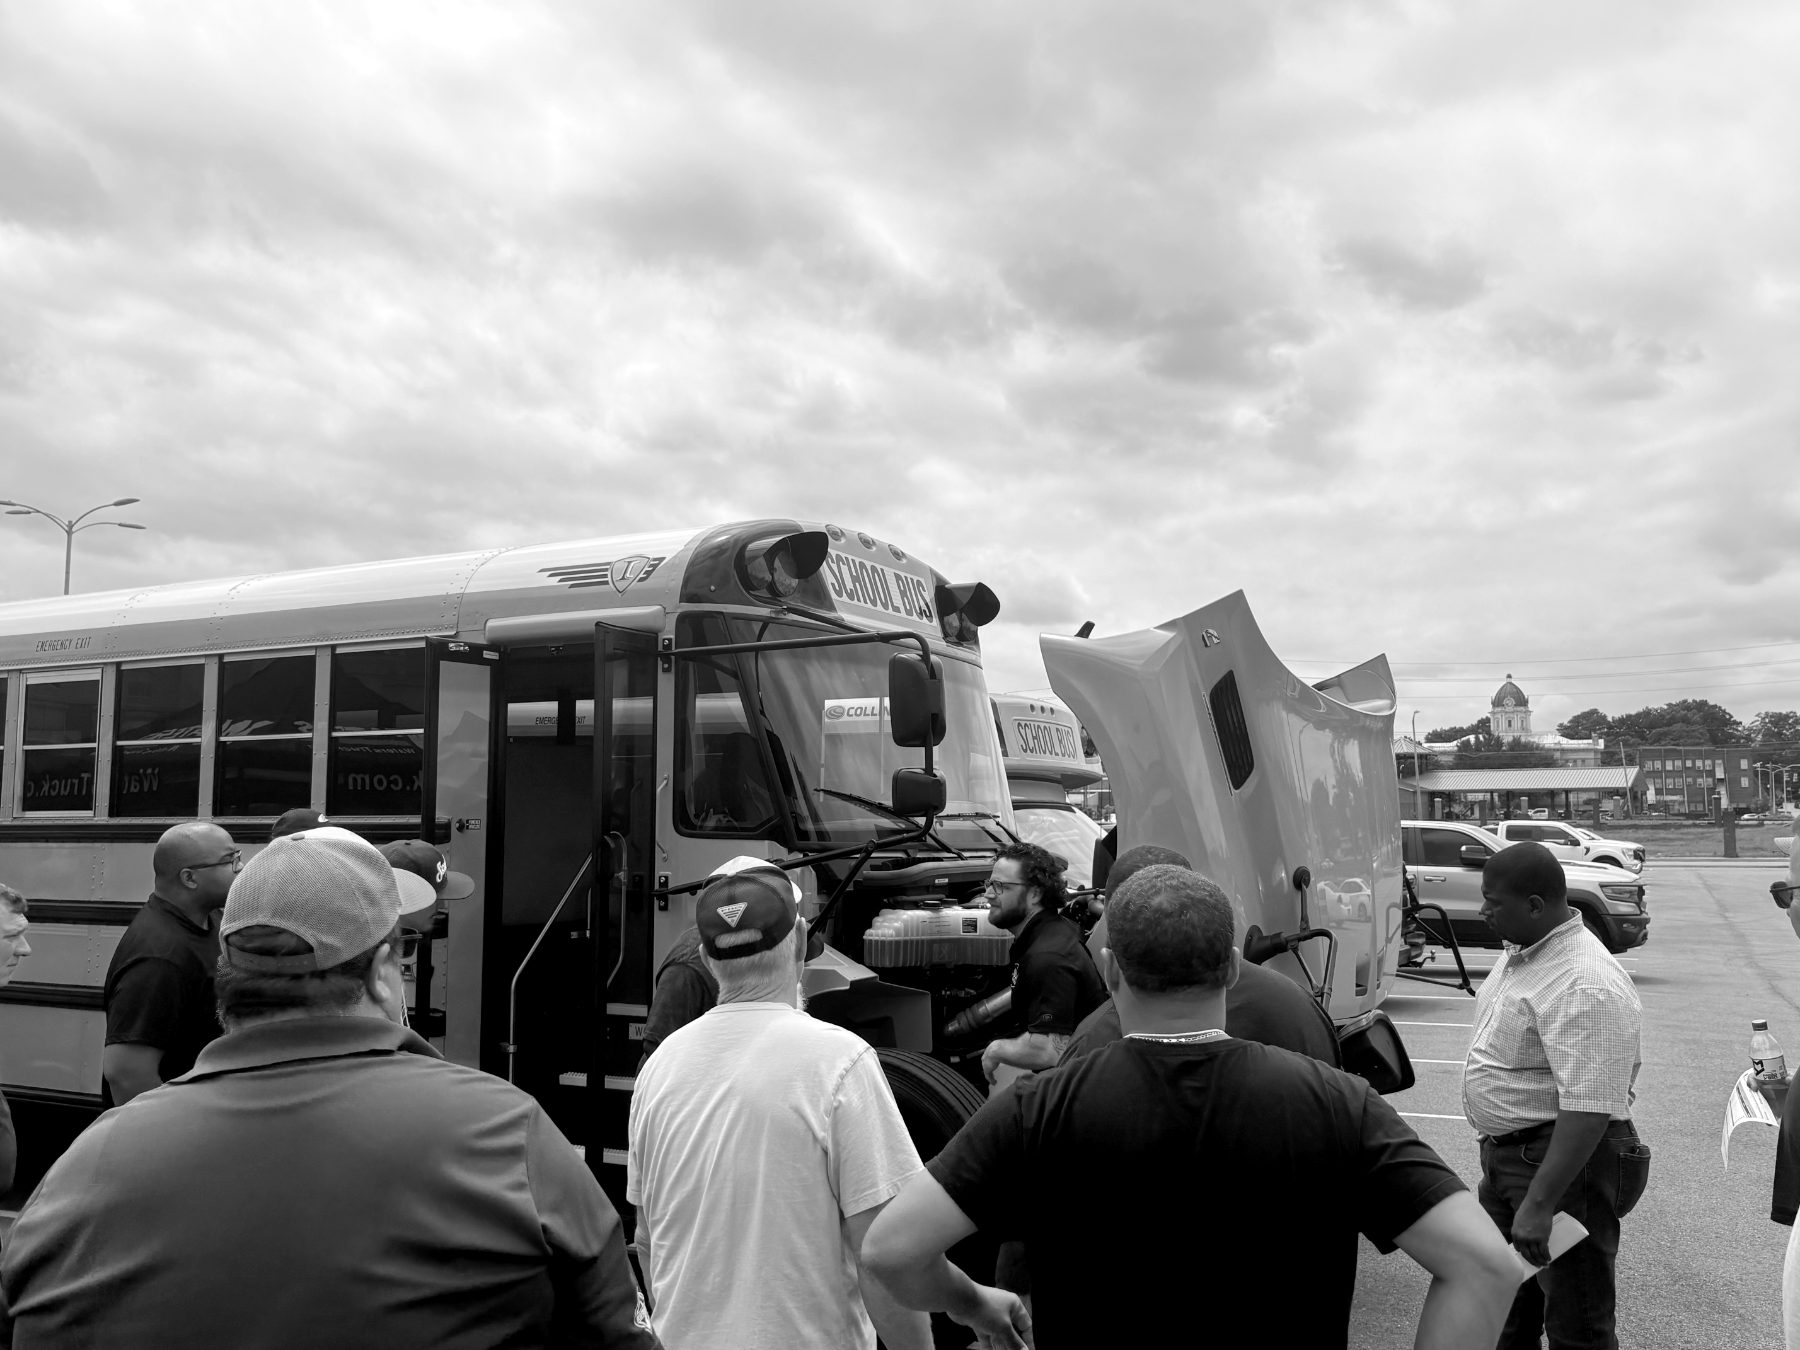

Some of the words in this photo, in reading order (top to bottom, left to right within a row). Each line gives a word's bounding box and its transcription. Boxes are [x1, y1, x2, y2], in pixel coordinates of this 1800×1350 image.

[825, 551, 902, 614] SCHOOL
[893, 571, 934, 623] BUS
[35, 638, 74, 653] EMERGENCY
[74, 636, 92, 650] EXIT
[1016, 721, 1060, 757] SCHOOL
[1055, 727, 1076, 760] BUS
